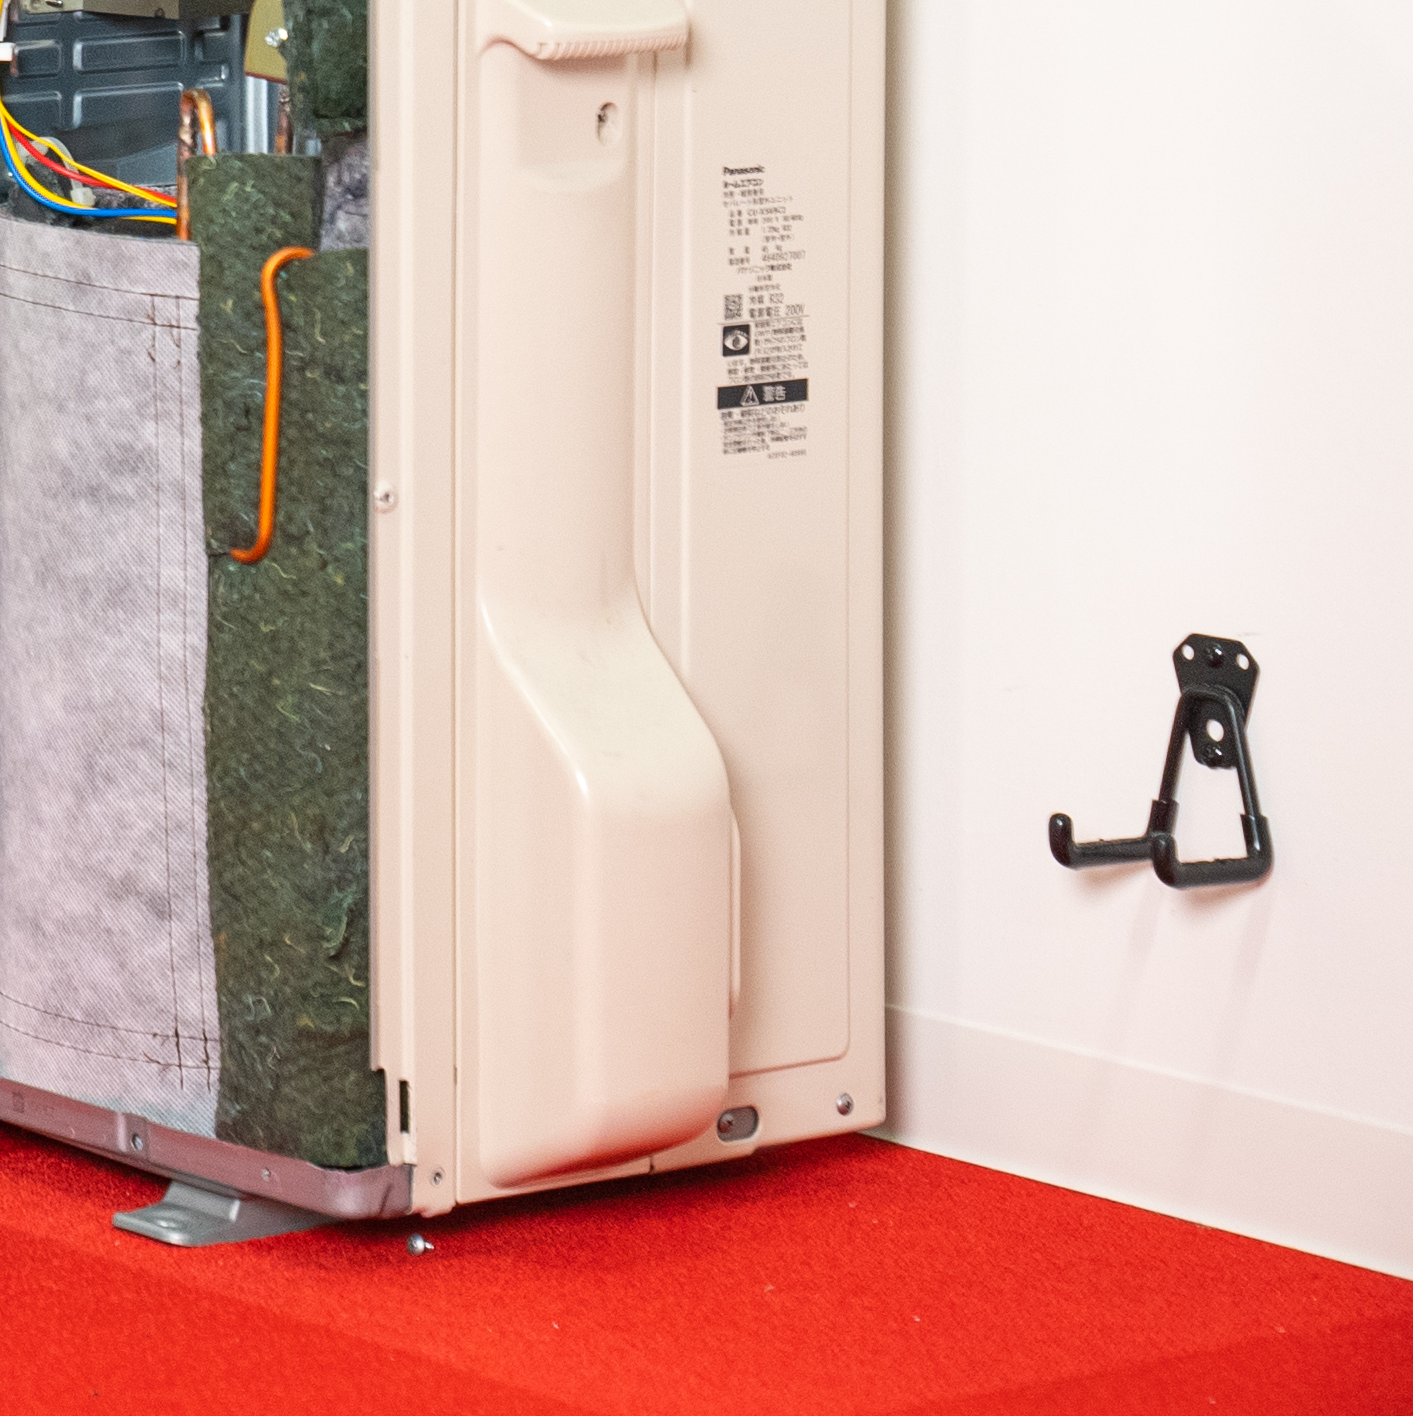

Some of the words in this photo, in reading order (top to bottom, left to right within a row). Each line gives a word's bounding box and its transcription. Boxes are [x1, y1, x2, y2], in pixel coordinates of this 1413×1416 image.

[723, 165, 765, 175] Panasonic
[769, 292, 784, 304] R32
[785, 304, 805, 316] 200V
[762, 385, 787, 402] 警告
